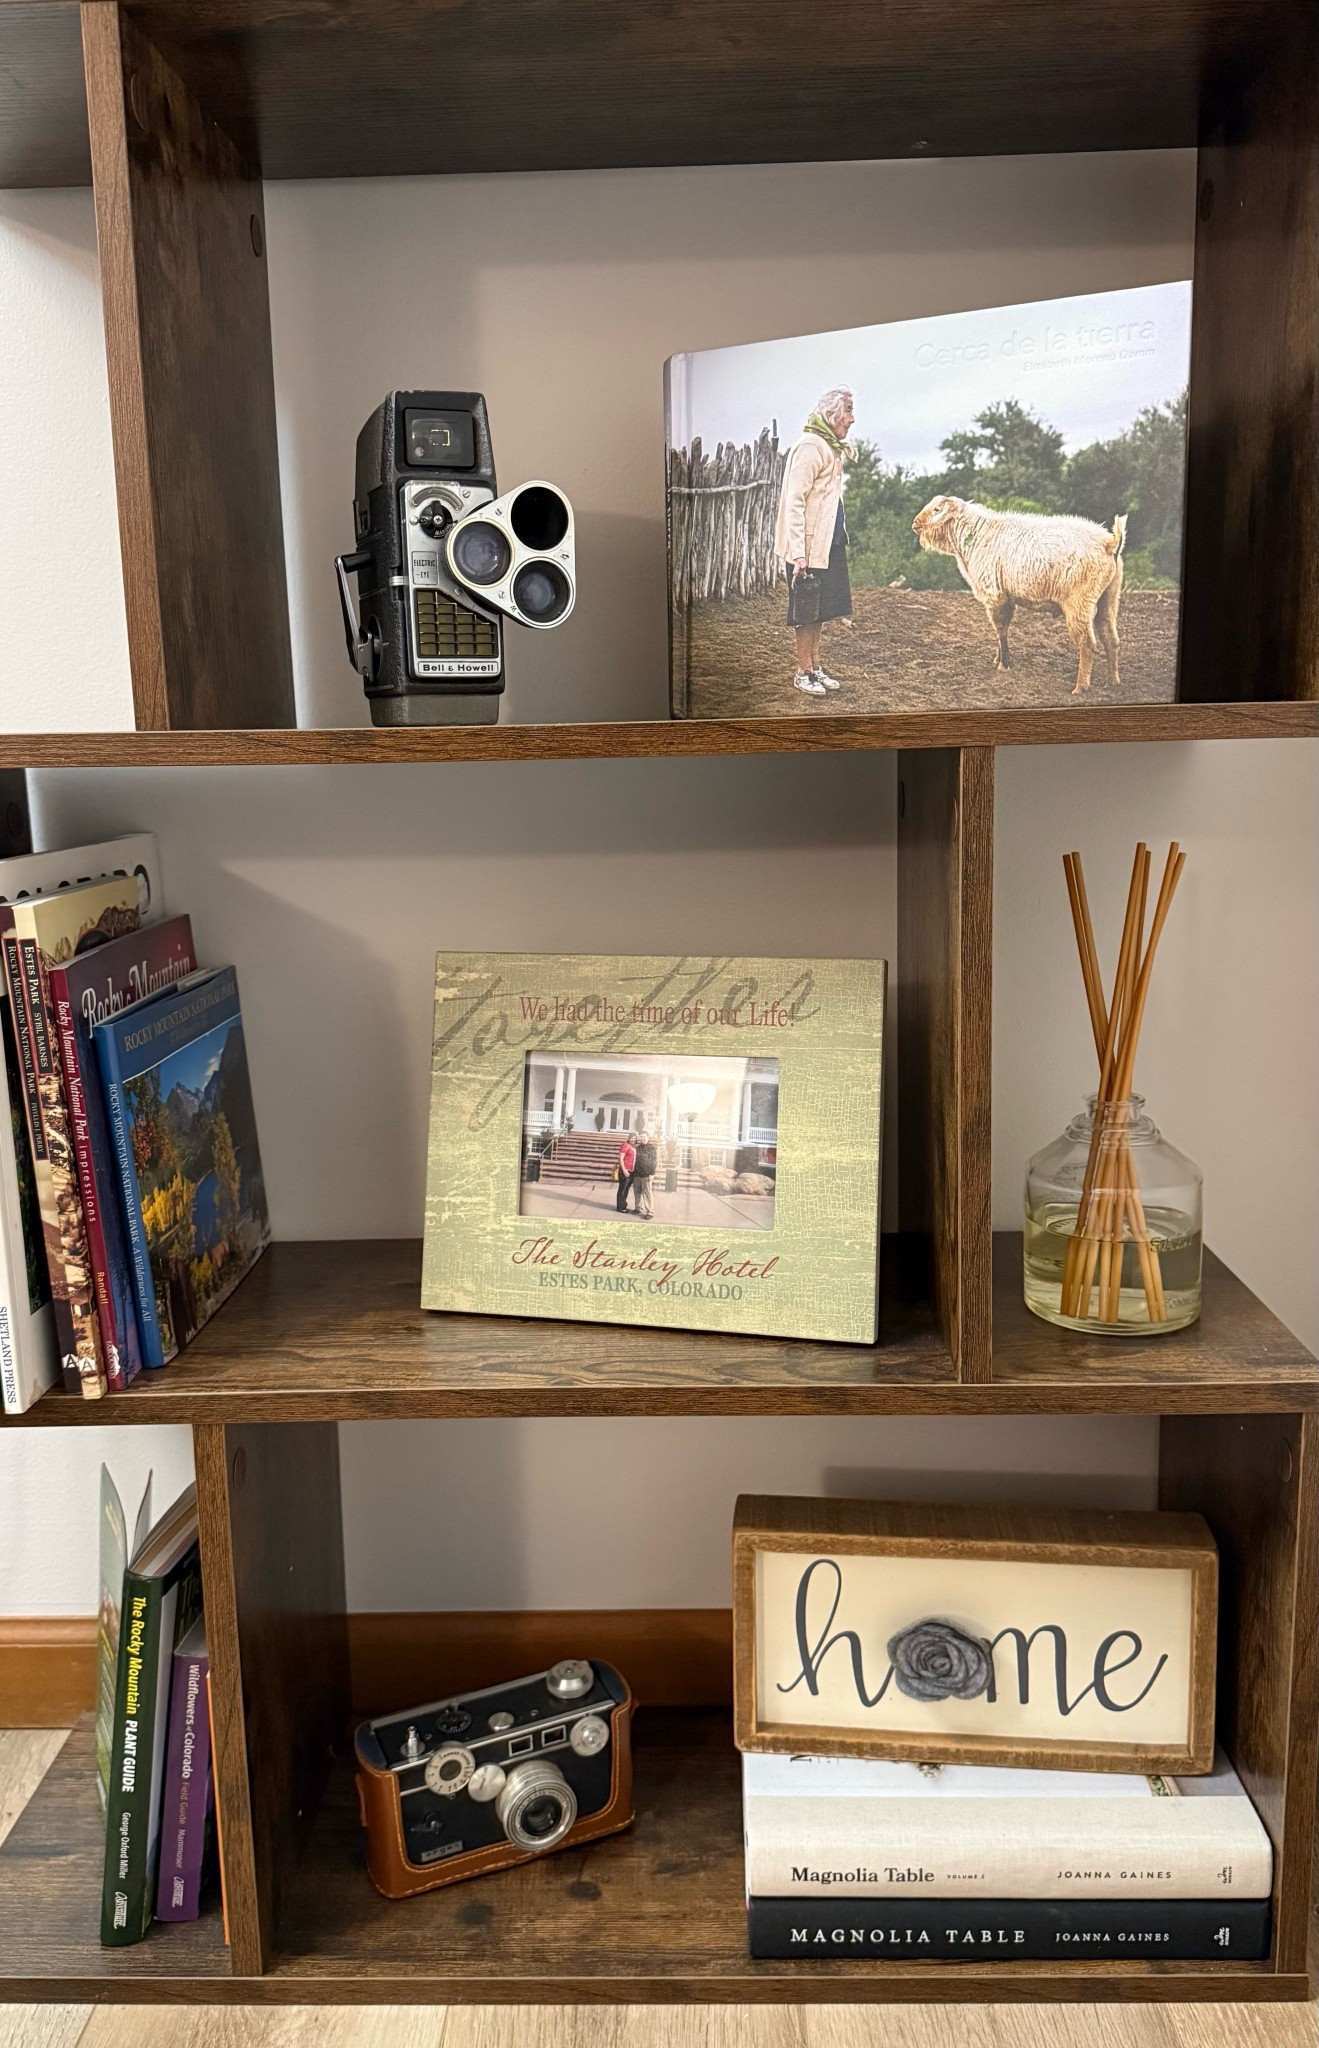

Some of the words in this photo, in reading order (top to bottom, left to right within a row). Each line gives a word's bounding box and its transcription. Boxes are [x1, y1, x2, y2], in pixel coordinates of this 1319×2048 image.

[912, 342, 991, 369] Cerca
[1000, 330, 1035, 357] de
[1045, 326, 1068, 352] la
[1077, 320, 1155, 347] tierra
[1074, 351, 1116, 366] Moreno
[1119, 347, 1155, 360] Damm
[413, 559, 437, 567] ELECTRIC
[420, 571, 430, 579] EYE
[422, 664, 445, 672] Bell
[448, 664, 454, 672] &
[457, 664, 494, 672] Howell
[7, 945, 19, 975] ROCKY
[24, 946, 36, 976] ESTES
[129, 943, 190, 1001] Mountain
[13, 977, 26, 1024] MOUNTAIN
[28, 978, 40, 1005] PARK
[57, 1000, 72, 1026] Rocky
[518, 996, 548, 1022] We
[554, 995, 588, 1022] had
[595, 996, 625, 1023] the
[632, 1000, 674, 1025] time
[681, 999, 703, 1025] of
[706, 1007, 742, 1026] our
[749, 1000, 796, 1028] Life!
[124, 1026, 153, 1052] ROCKY
[153, 1006, 191, 1037] MOUNTAIN
[20, 1026, 33, 1070] NATIONAL
[37, 1035, 49, 1068] BARNES
[62, 1029, 79, 1073] Mountain
[26, 1072, 37, 1094] PARK
[69, 1077, 86, 1116] National
[109, 1083, 121, 1115] ROCKY
[75, 1119, 89, 1140] Park
[113, 1116, 129, 1169] MOUNTAIN
[79, 1145, 97, 1222] impressions
[122, 1170, 136, 1218] NATIONAL
[127, 1217, 140, 1243] PARK
[134, 1255, 147, 1297] Wilderness
[511, 1236, 564, 1265] The
[572, 1240, 684, 1287] Stanley
[691, 1247, 780, 1280] Hotel
[97, 1271, 109, 1305] Randall
[140, 1297, 150, 1307] for
[538, 1271, 588, 1290] ESTES
[593, 1274, 643, 1297] PARK,
[647, 1278, 743, 1301] COLORADO
[142, 1309, 152, 1322] All
[0, 1306, 12, 1367] SHETLAND
[5, 1369, 17, 1404] PRESS
[132, 1597, 147, 1618] The
[126, 1619, 145, 1655] Rocky
[776, 1559, 1169, 1716] hme
[126, 1656, 143, 1715] Mountain
[185, 1664, 200, 1726] Wildflowers
[124, 1719, 138, 1756] PLANT
[182, 1732, 195, 1779] Colorado
[122, 1758, 136, 1793] GUIDE
[180, 1781, 190, 1800] Field
[119, 1811, 131, 1836] George
[179, 1800, 188, 1825] Guide
[120, 1836, 130, 1858] Oxford
[176, 1828, 186, 1868] Mammoser
[119, 1859, 129, 1879] Miller
[791, 1867, 879, 1885] Magnolia
[884, 1867, 935, 1883] Table
[1057, 1871, 1111, 1879] JOANNA
[1120, 1871, 1172, 1879] GAINES
[790, 1928, 931, 1944] MAGNOLIA
[946, 1928, 1026, 1944] TABLE
[1055, 1932, 1111, 1942] JOANNA
[1117, 1932, 1170, 1942] GAINES
